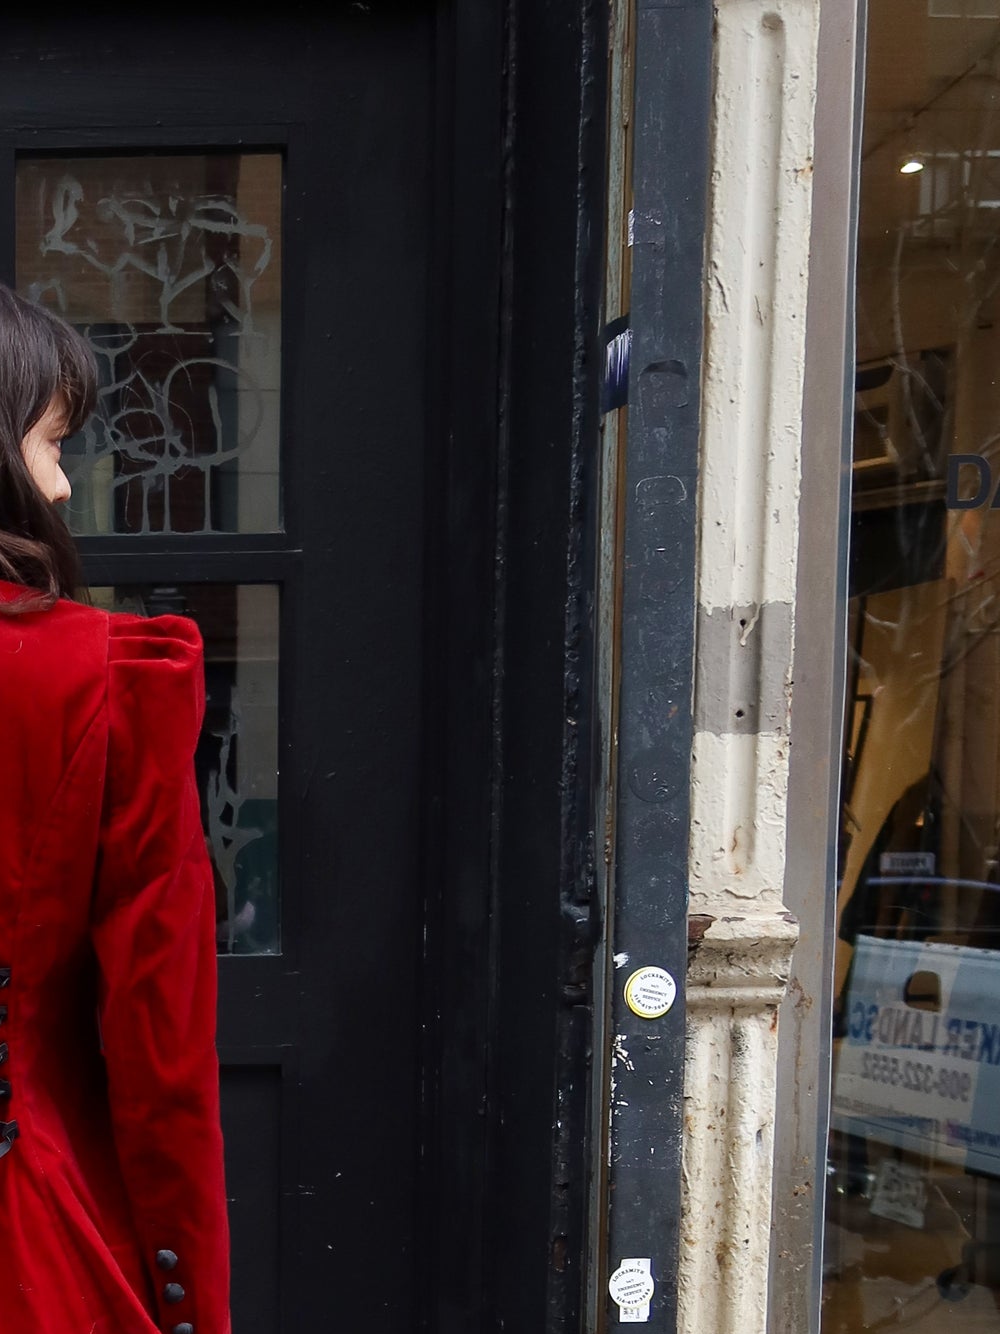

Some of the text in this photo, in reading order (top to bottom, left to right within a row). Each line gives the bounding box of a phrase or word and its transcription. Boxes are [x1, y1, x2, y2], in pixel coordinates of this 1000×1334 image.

[947, 454, 1000, 509] D
[640, 973, 673, 987] LOCKSMITH
[613, 1268, 645, 1283] LOCKSMITH
